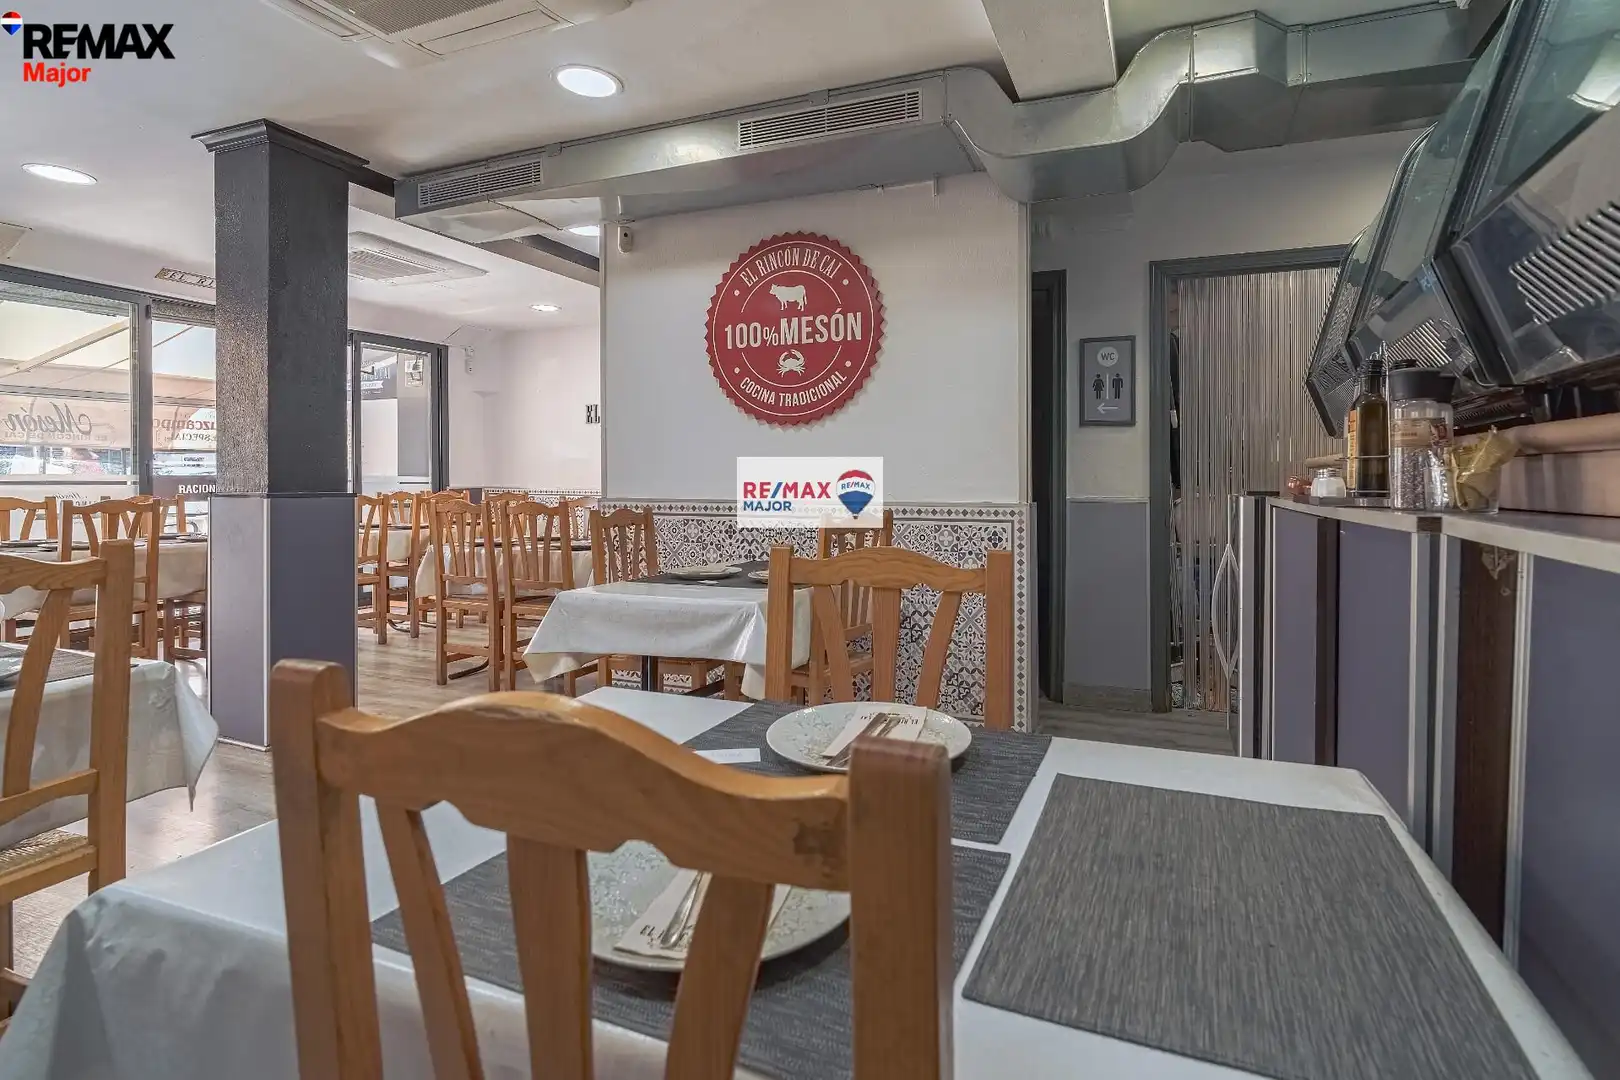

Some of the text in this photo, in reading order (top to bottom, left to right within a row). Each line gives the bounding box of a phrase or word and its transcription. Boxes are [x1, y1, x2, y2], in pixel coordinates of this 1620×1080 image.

[740, 246, 843, 287] EL RINCÓN DE CAI
[1101, 352, 1115, 361] WC
[739, 371, 847, 407] COCINA TRADICIONAL
